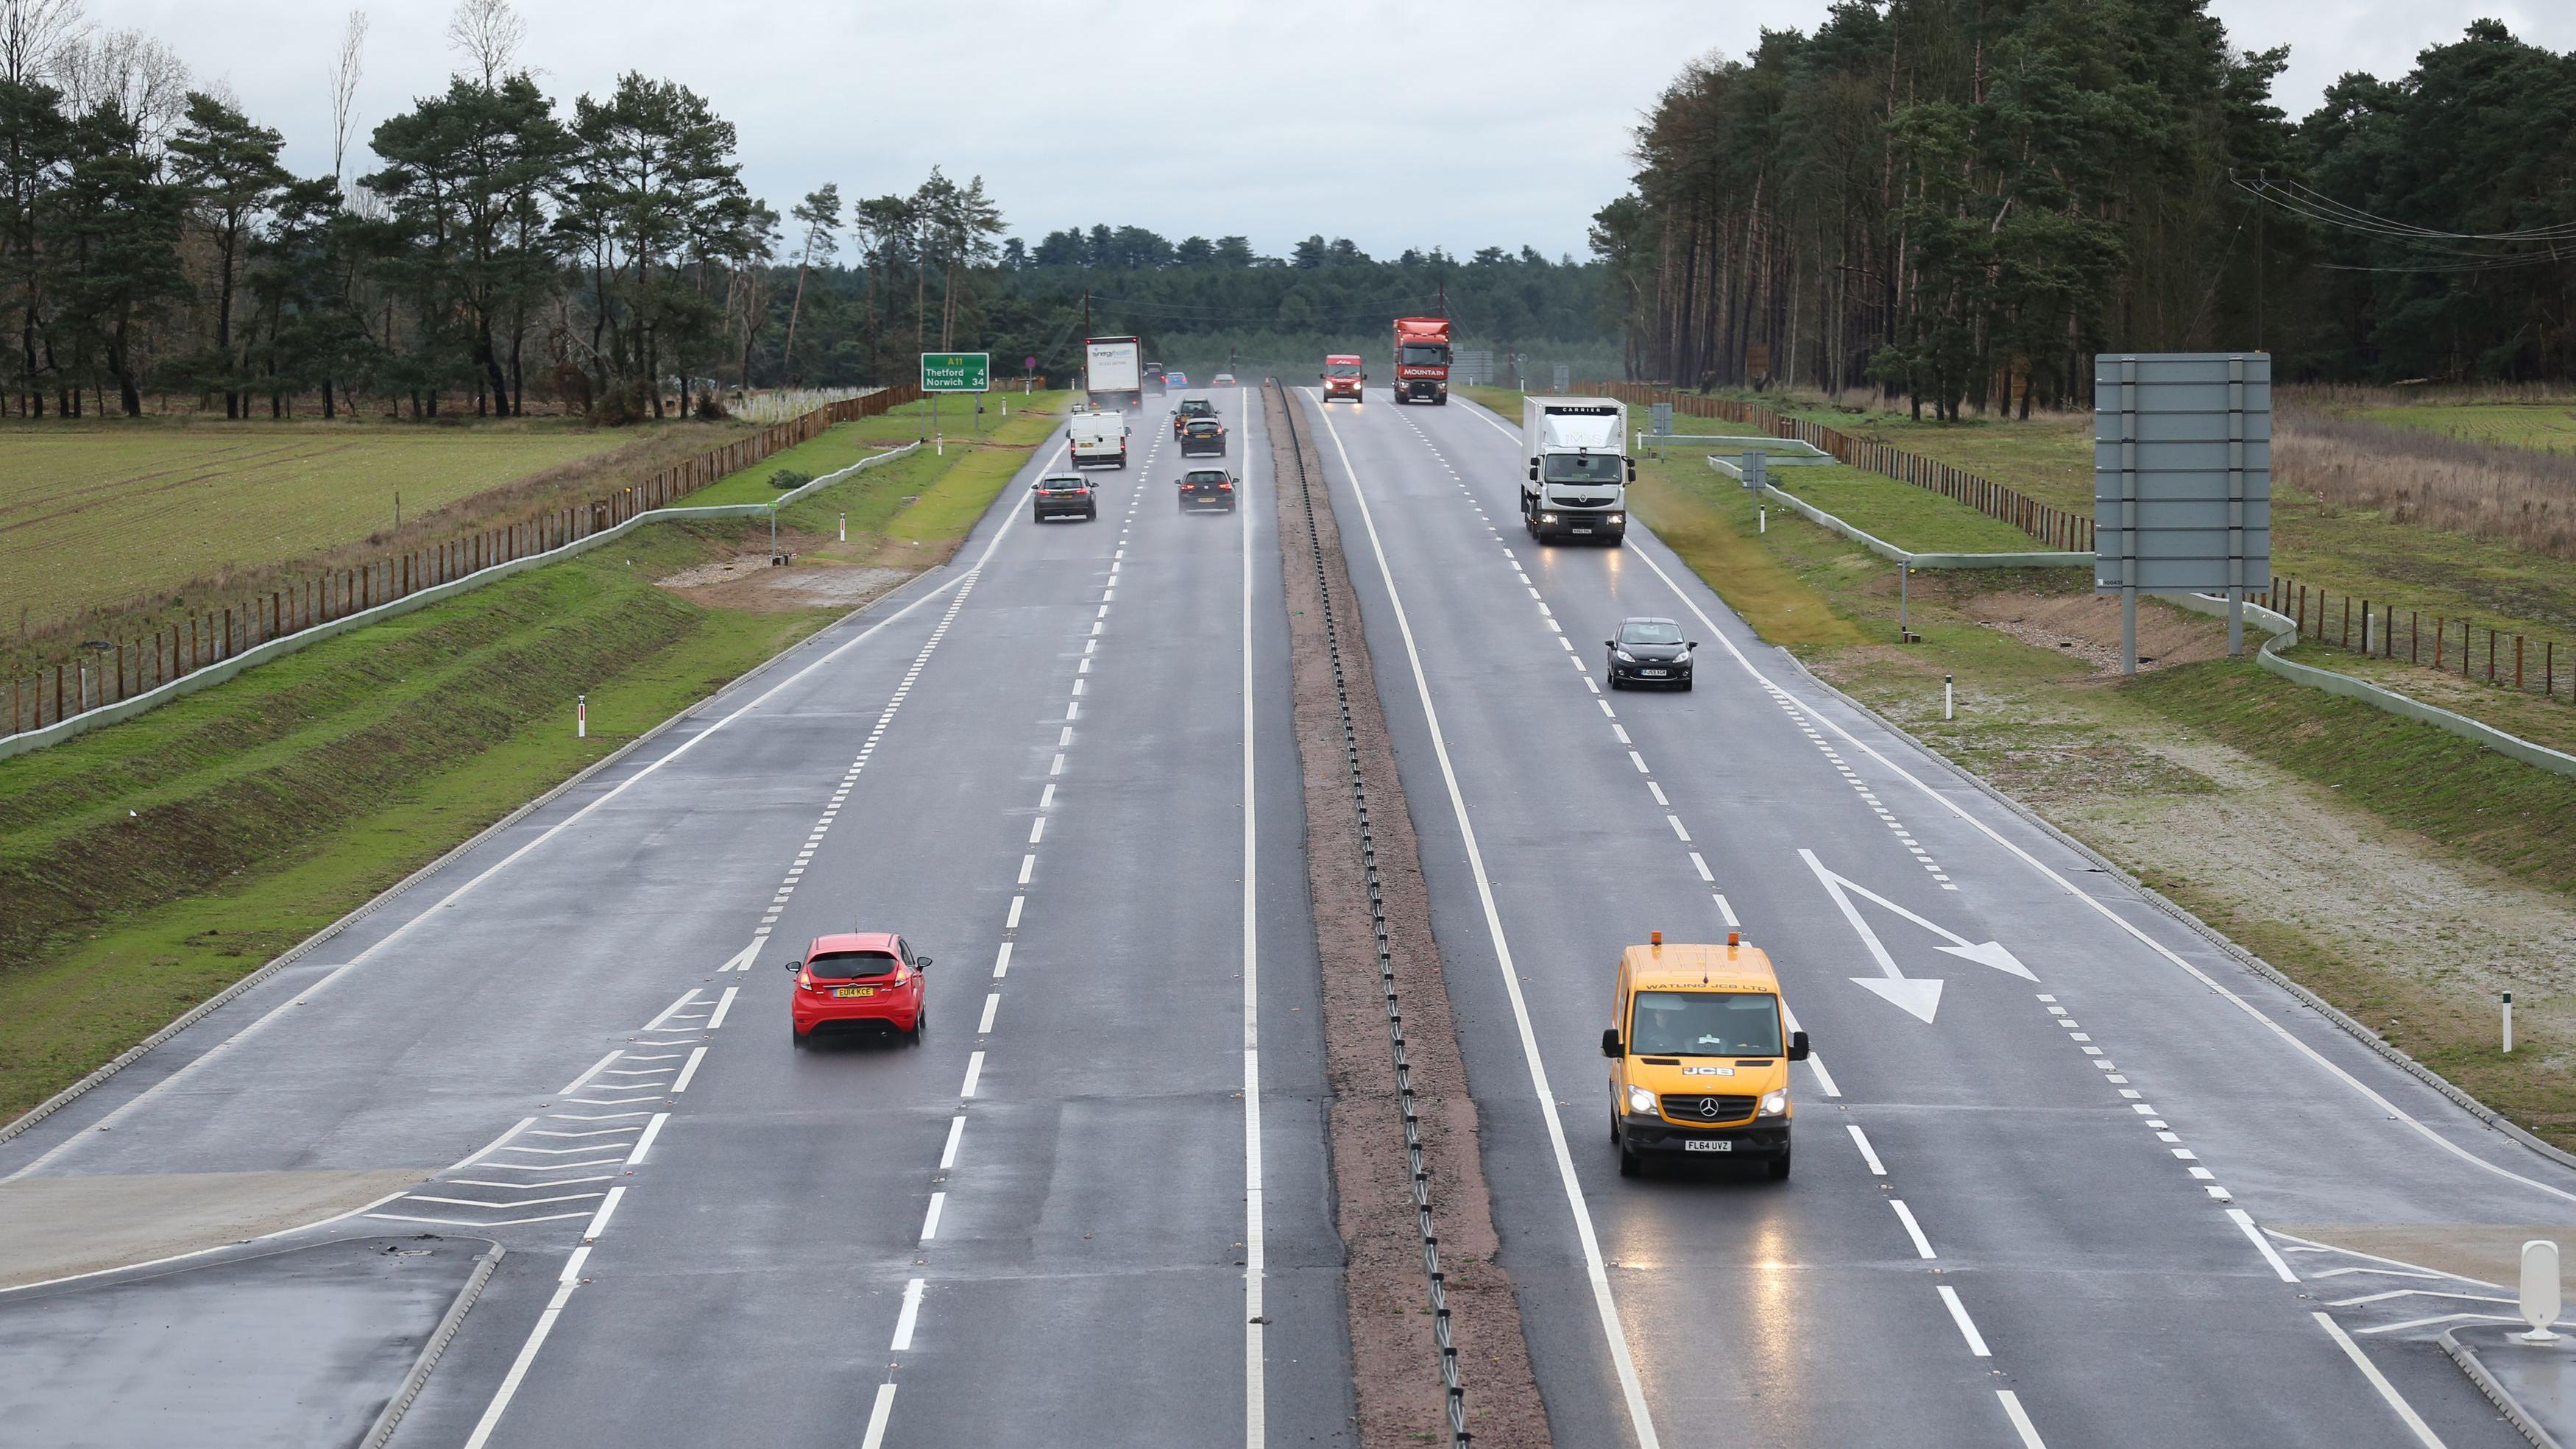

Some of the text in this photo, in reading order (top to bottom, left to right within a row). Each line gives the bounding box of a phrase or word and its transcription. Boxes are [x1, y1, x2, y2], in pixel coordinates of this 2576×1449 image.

[1683, 1067, 1734, 1077] JCB
[1688, 1141, 1727, 1149] FL64 UVZ
